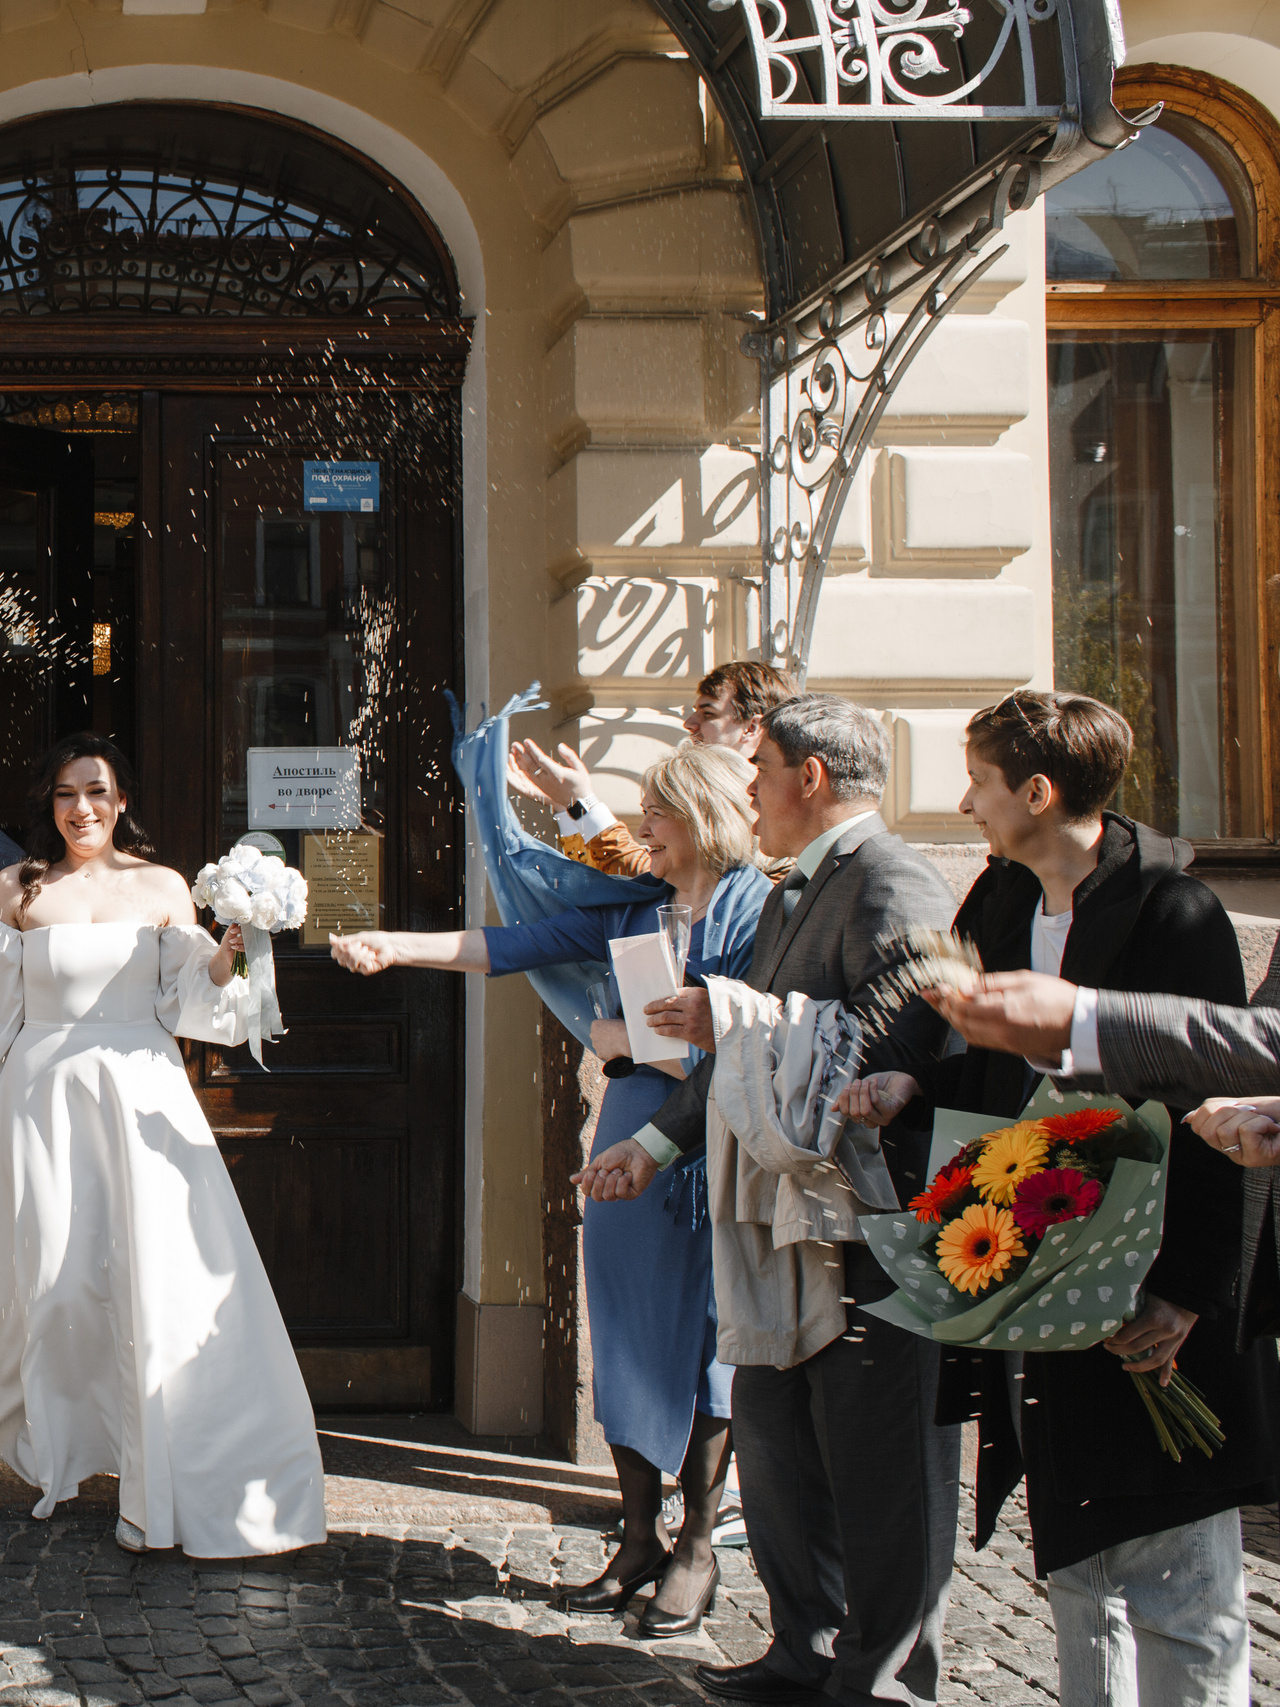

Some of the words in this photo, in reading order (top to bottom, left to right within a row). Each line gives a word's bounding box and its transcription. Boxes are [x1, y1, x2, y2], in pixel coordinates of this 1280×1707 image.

[311, 474, 330, 482] ПОД
[331, 473, 372, 482] ОХРАНОЙ
[273, 766, 336, 777] Апостиль
[277, 788, 293, 797] во
[295, 787, 333, 799] дворе
